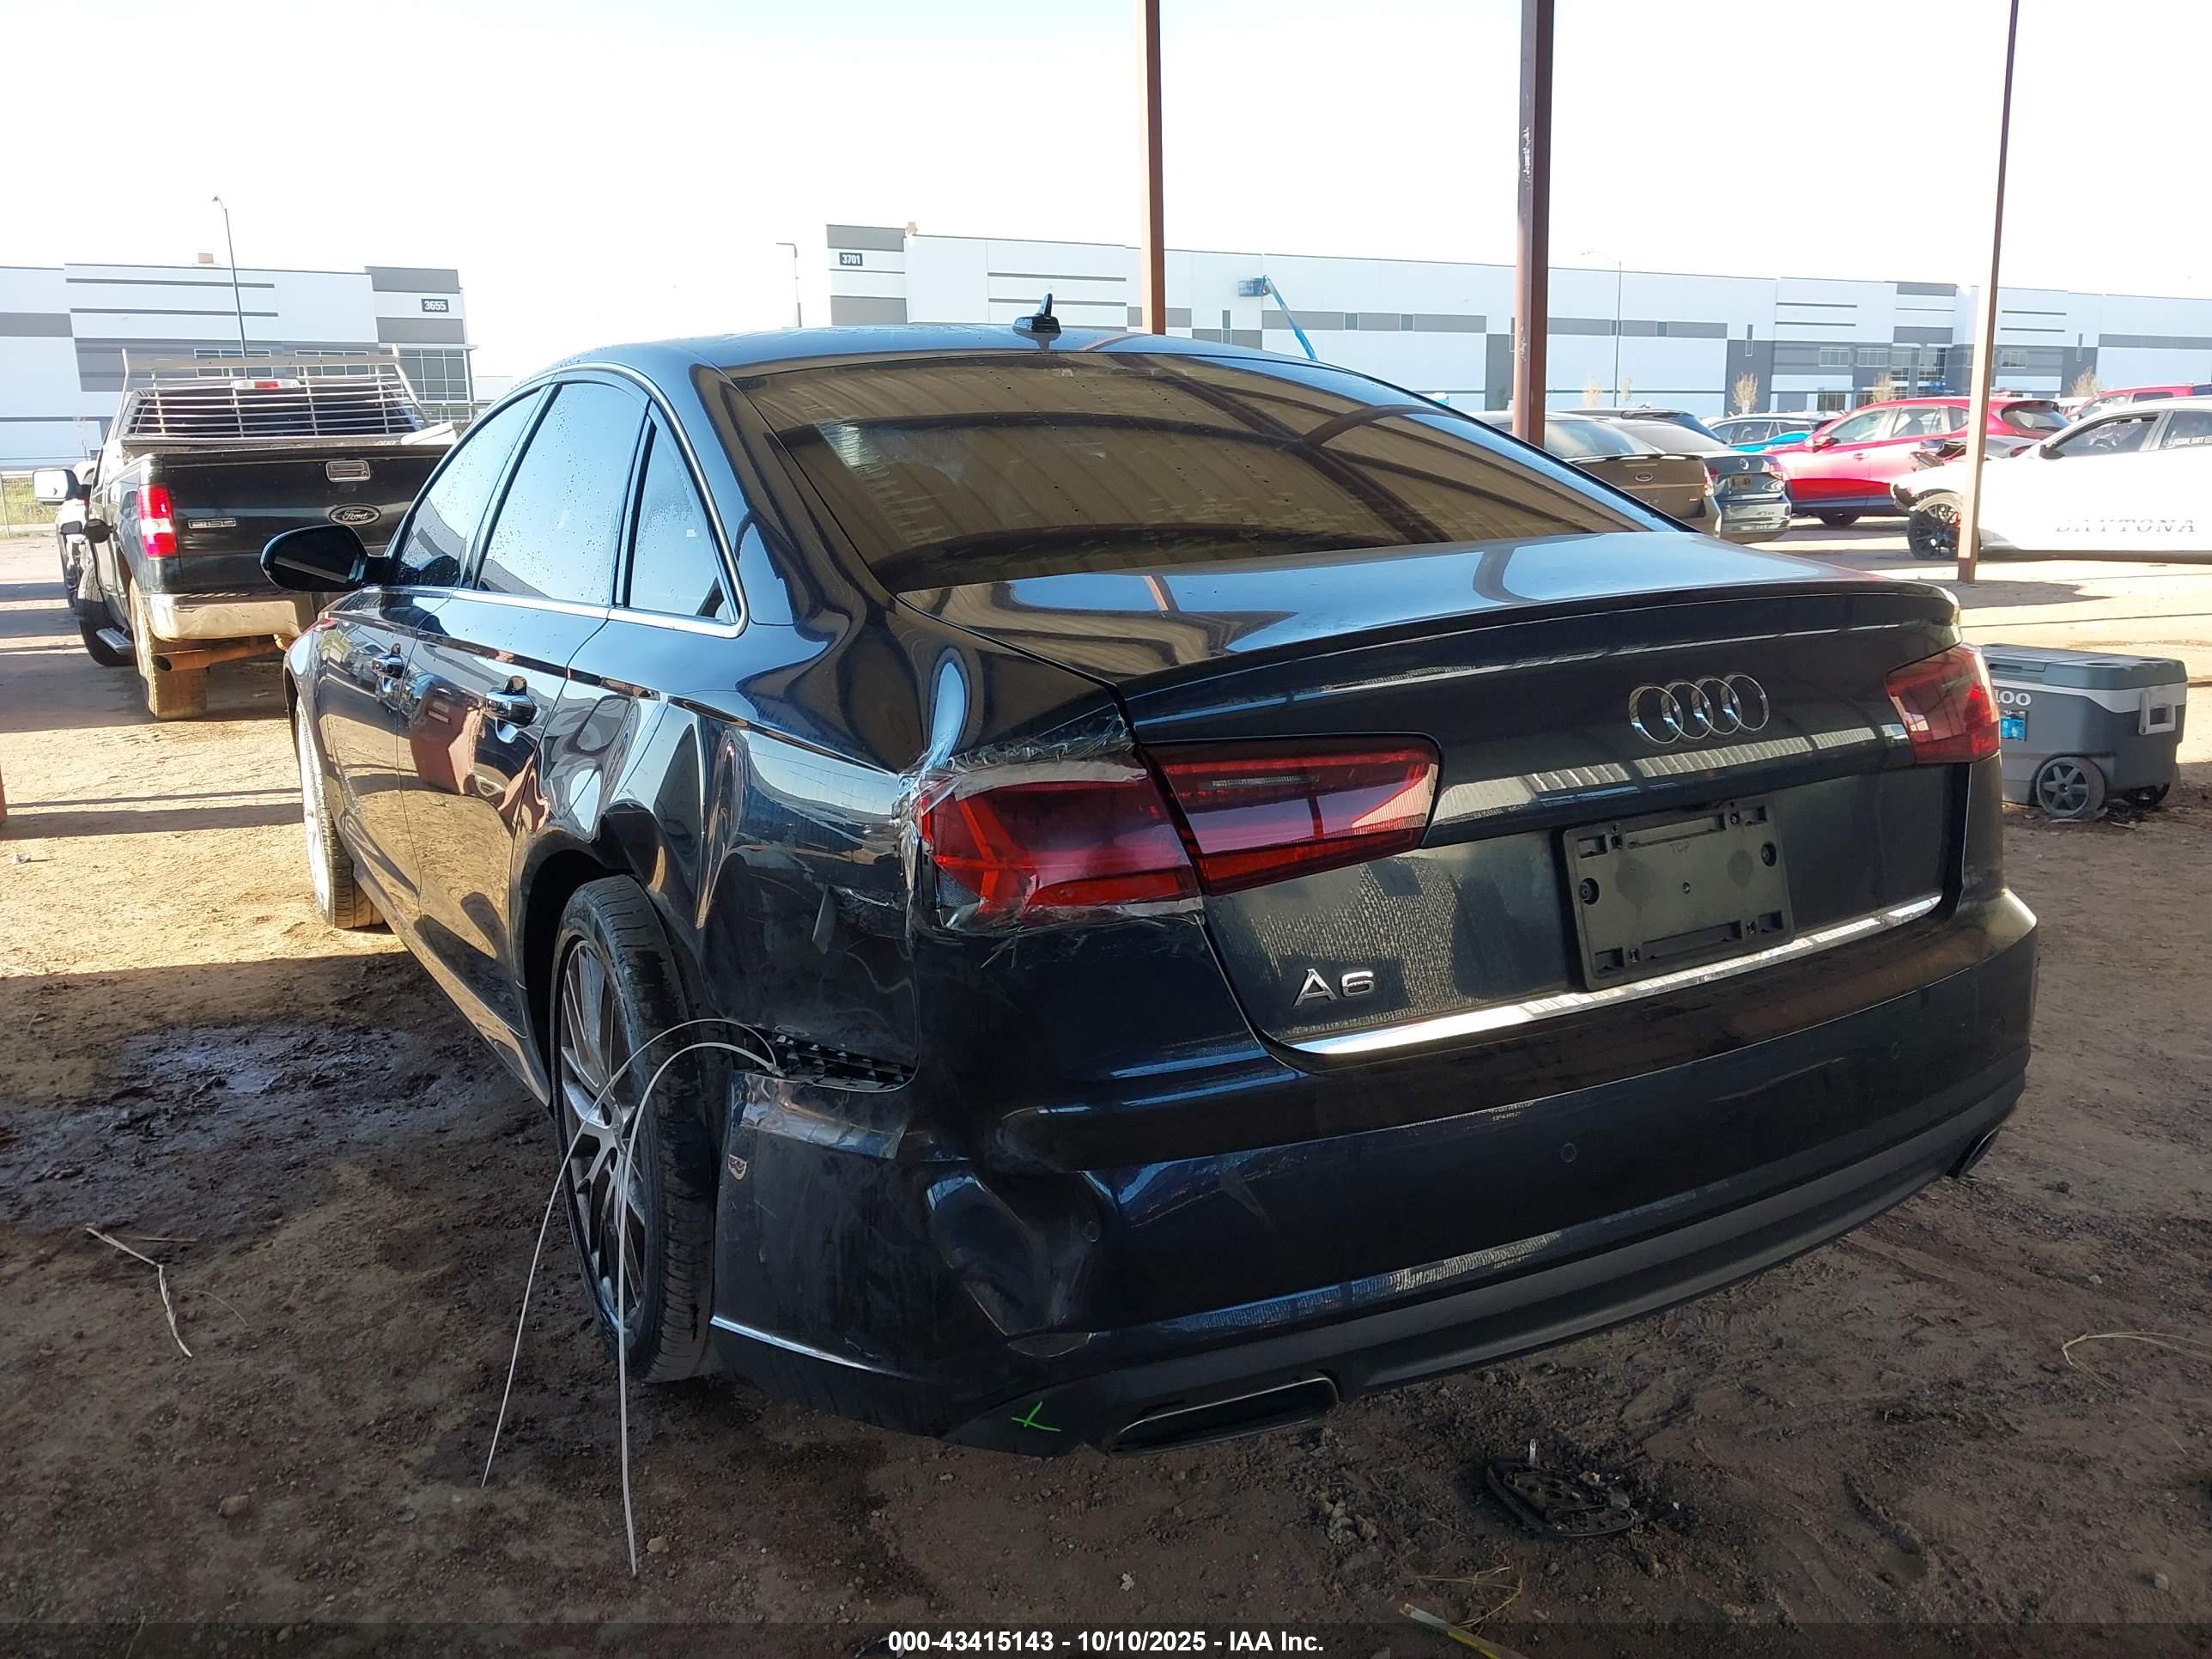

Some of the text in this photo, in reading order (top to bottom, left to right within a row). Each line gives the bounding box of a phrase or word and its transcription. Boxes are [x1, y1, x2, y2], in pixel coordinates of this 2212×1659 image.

[842, 253, 861, 264] 3701
[423, 300, 447, 311] 3655
[1291, 968, 1375, 1007] A6
